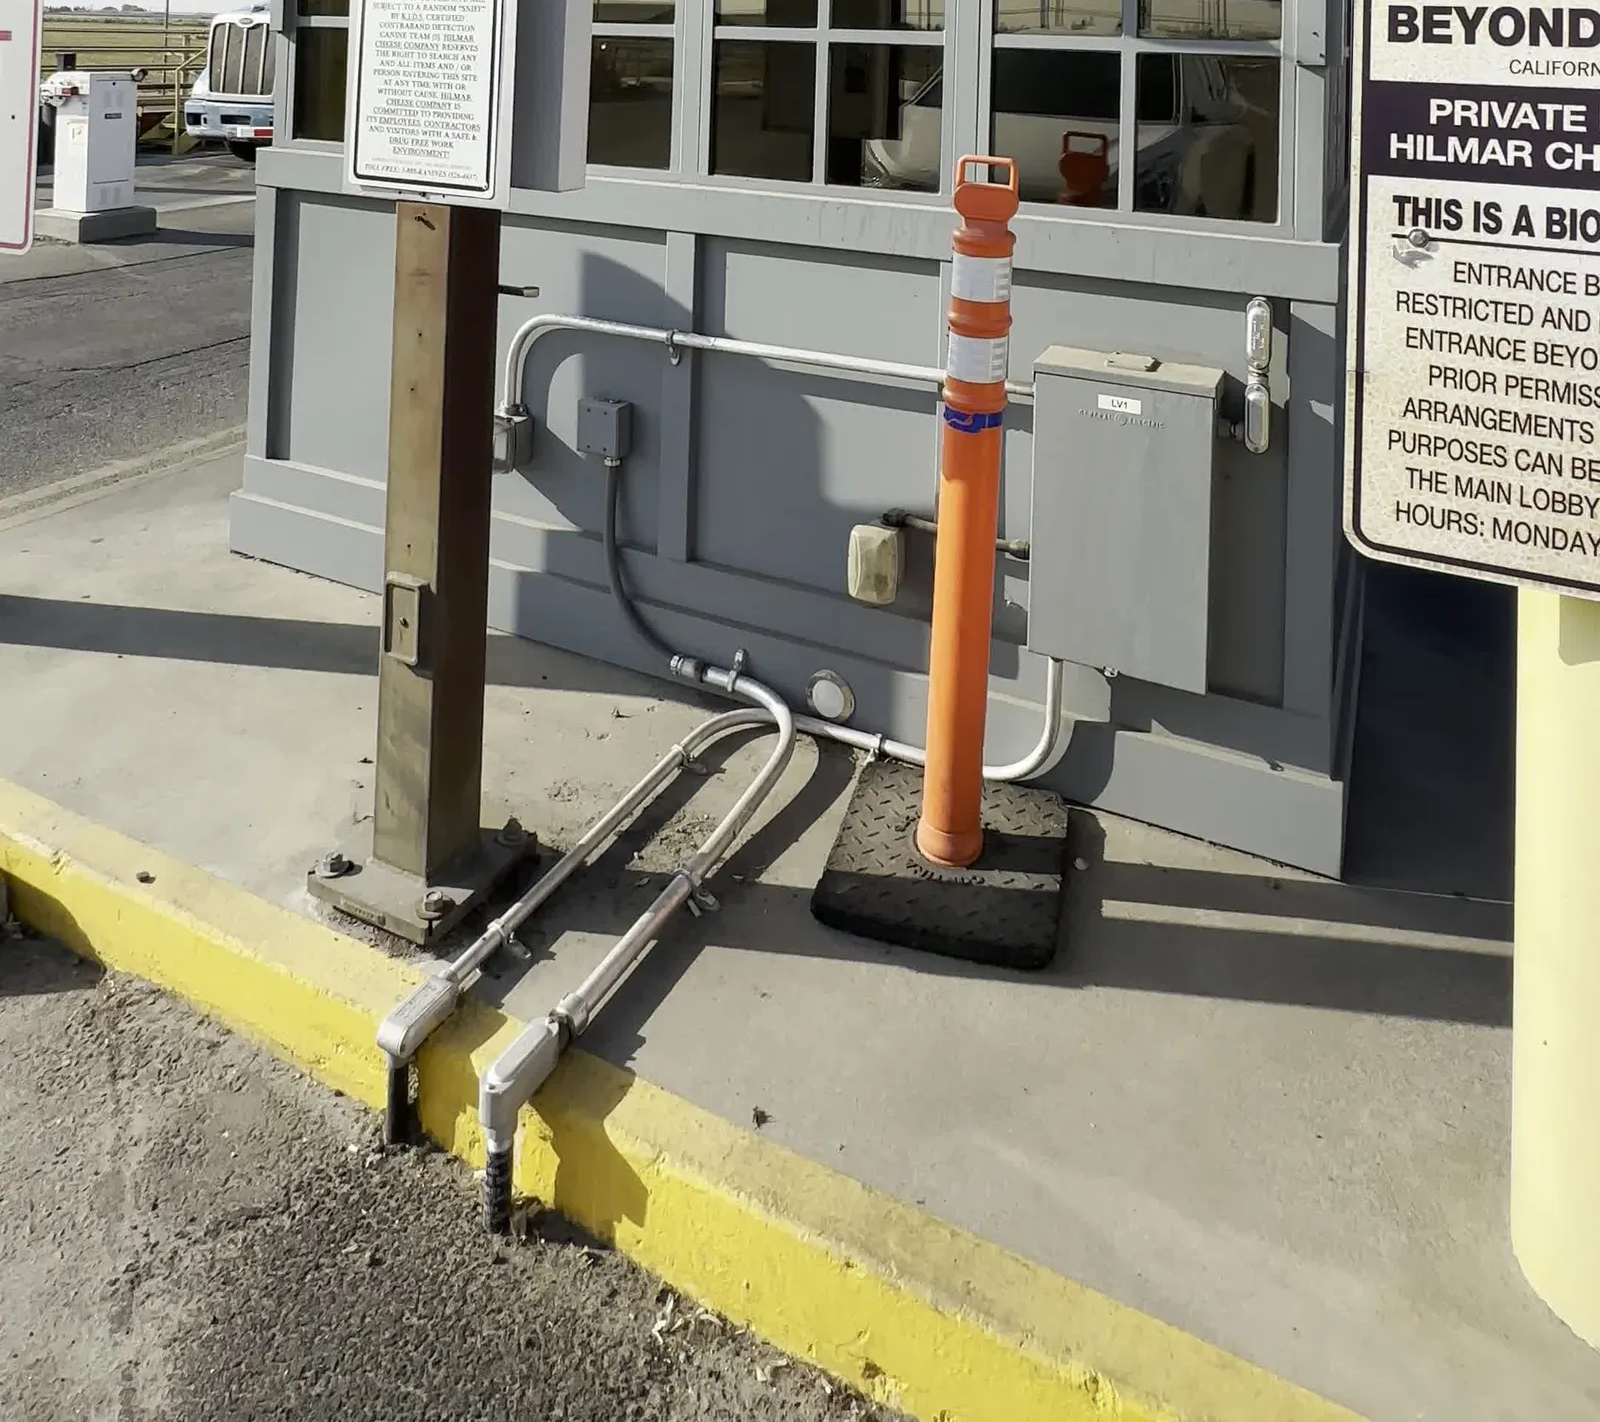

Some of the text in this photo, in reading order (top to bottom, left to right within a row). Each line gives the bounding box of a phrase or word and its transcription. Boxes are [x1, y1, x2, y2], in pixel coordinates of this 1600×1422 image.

[1387, 4, 1600, 48] BEYOND
[1509, 58, 1600, 77] CALIFORN
[1429, 98, 1587, 133] PRIVATE
[1389, 133, 1600, 172] HILMAR CH
[1392, 194, 1600, 243] THIS IS A BIO
[1453, 261, 1600, 297] ENTRANCE B
[1396, 290, 1591, 333] RESTRICTED AND
[1405, 327, 1599, 372] ENTRANCE BEYO
[1428, 365, 1497, 395] PRIOR
[1112, 399, 1128, 409] LV1
[1402, 396, 1595, 445] ARRANGEMENTS
[1388, 429, 1600, 483] PURPOSES CAN BE
[1405, 467, 1600, 520] THE MAIN LOBBY
[1395, 500, 1600, 558] HOURS: MONDAY
